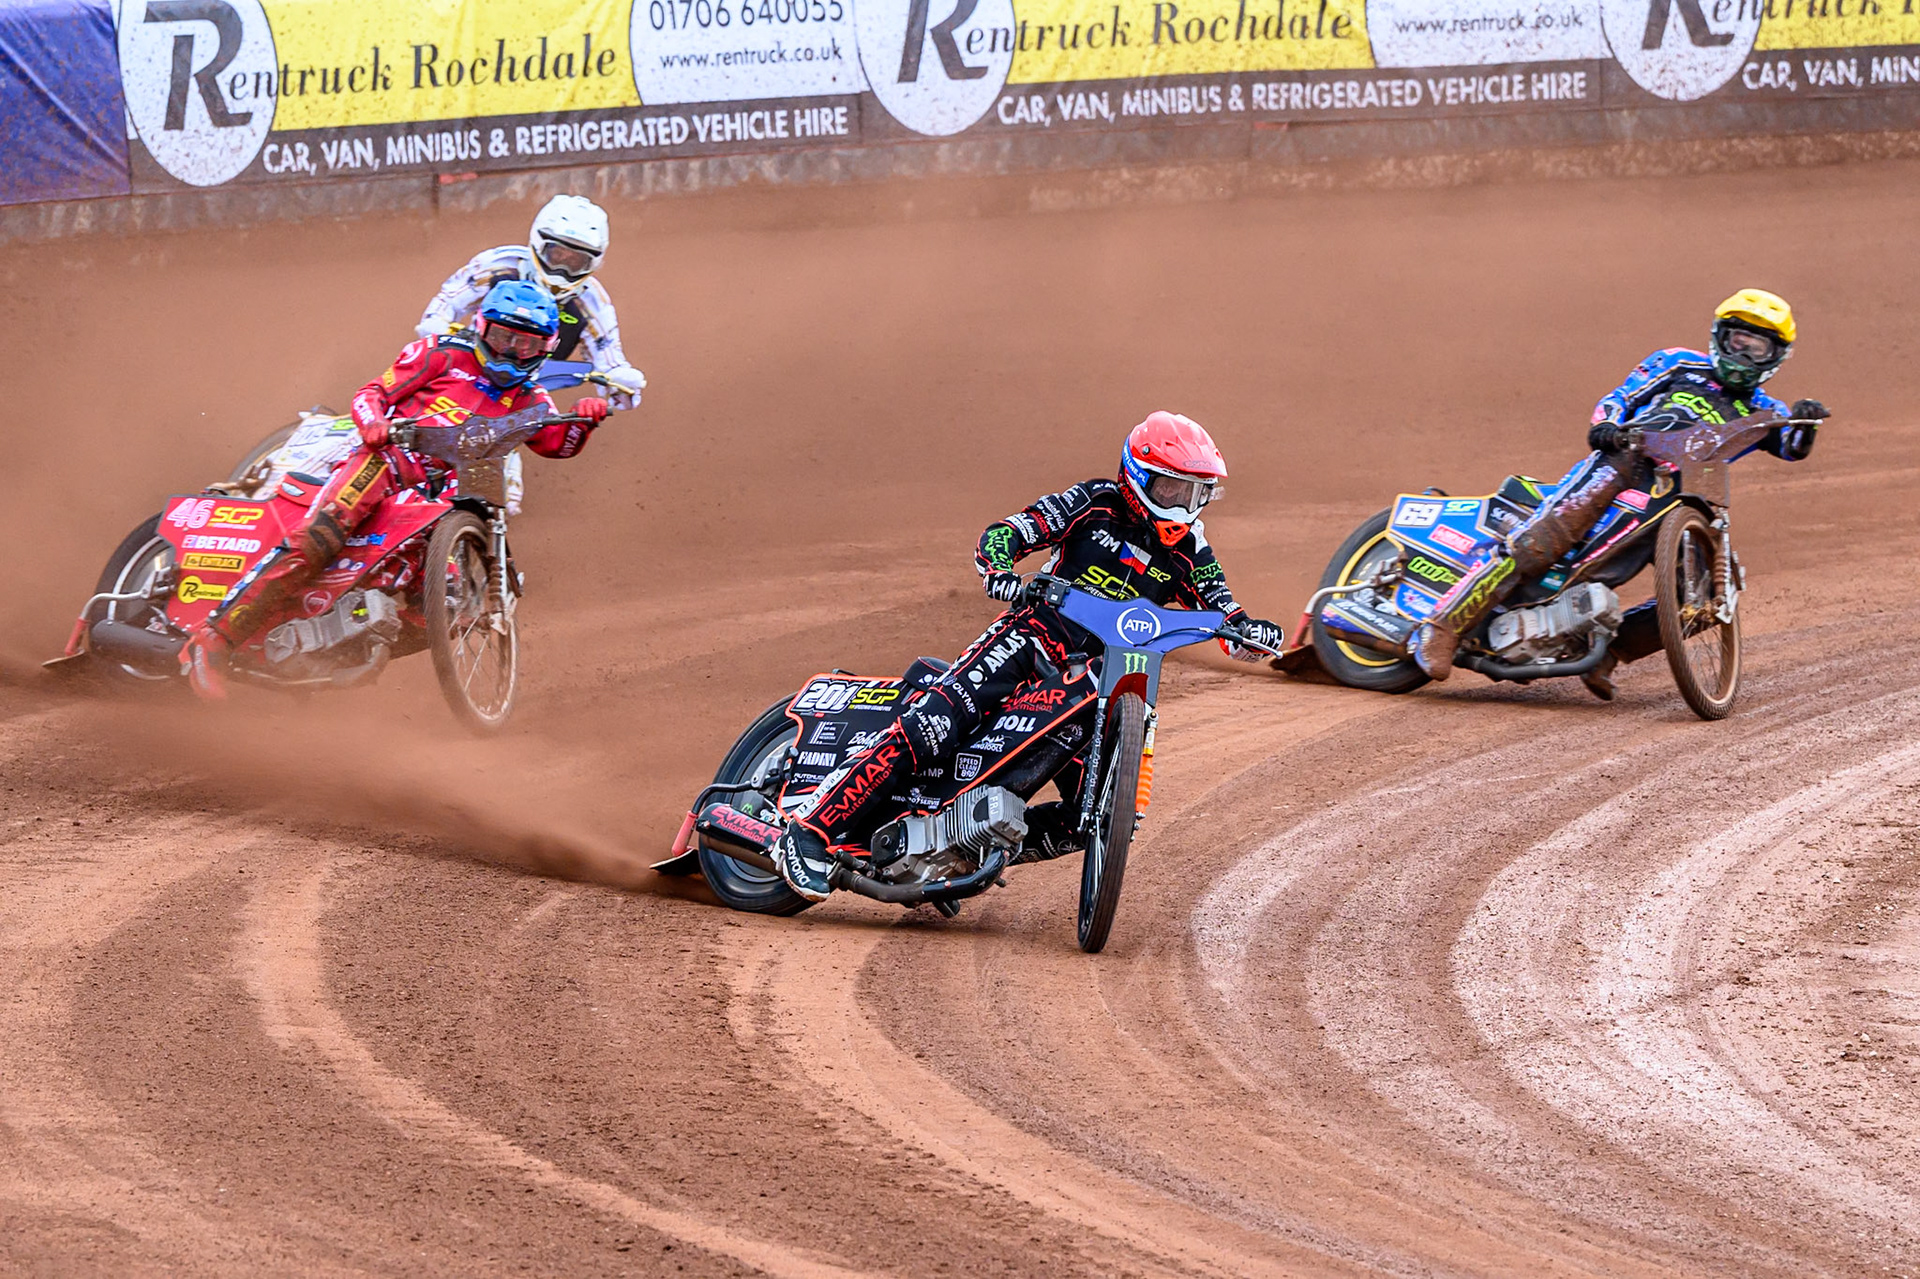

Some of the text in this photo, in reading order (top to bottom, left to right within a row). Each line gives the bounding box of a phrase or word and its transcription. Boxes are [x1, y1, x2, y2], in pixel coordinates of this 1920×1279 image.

[649, 0, 843, 30] 01706 640055
[1395, 5, 1584, 34] www.rentruck.co.uk
[659, 37, 843, 69] www.rentruck.co.uk
[897, 0, 1353, 84] Rentruck Rochdale
[143, 0, 616, 130] Rentruck Rochdale
[1742, 60, 1798, 93] CAR,
[1803, 57, 1864, 89] VAN,
[997, 71, 1588, 128] CAR, VAN, MINIBUS & REFRIGERATED VEHICLE HIRE
[262, 106, 850, 177] CAR, VAN, MINIBUS & REFRIGERATED VEHICLE HIRE
[166, 497, 265, 529] 46 SGP
[194, 534, 262, 553] BETARD
[1090, 528, 1122, 553] FIM
[1123, 618, 1154, 634] ATPI
[983, 628, 1027, 674] ANLAS
[795, 681, 901, 712] 201 SGP
[951, 682, 977, 714] OLYMP
[992, 714, 1037, 733] BOLL
[840, 764, 894, 821] Automation
[716, 817, 766, 844] Automation
